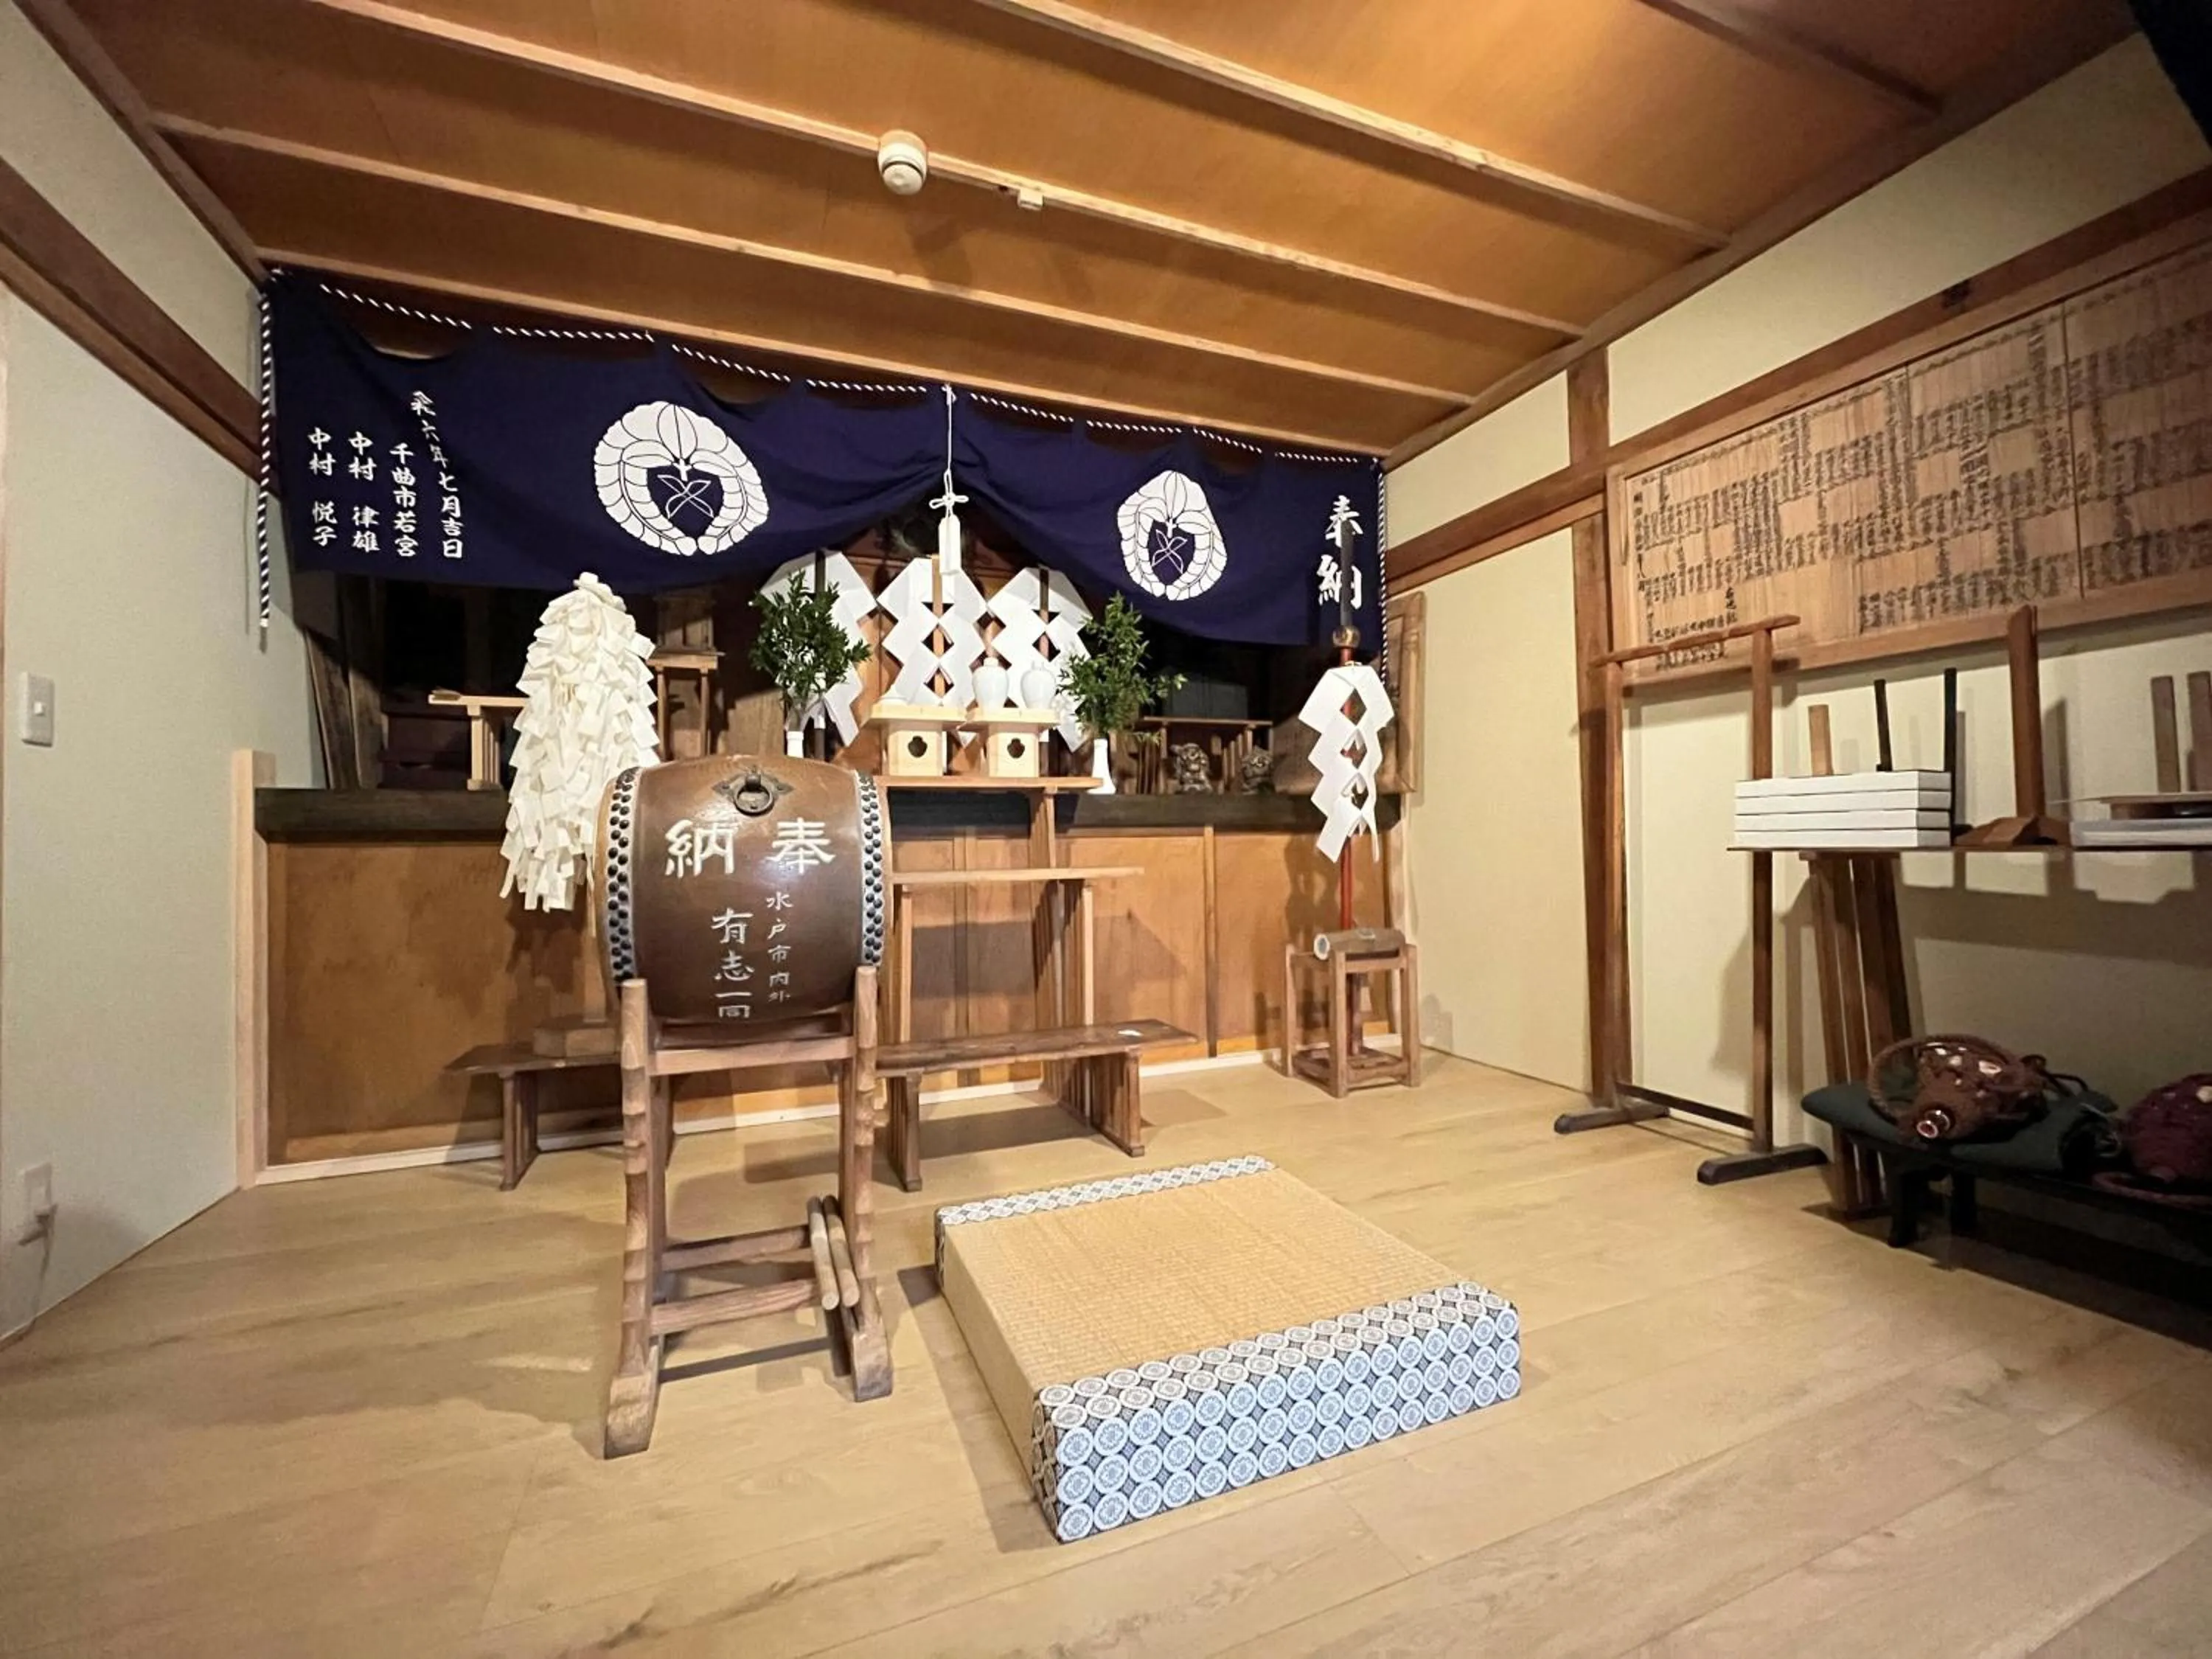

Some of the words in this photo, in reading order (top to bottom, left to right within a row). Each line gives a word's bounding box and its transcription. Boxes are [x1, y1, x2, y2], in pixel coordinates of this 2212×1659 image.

[307, 427, 336, 476] 中村
[348, 431, 378, 481] 中村
[312, 501, 338, 546] 悦子
[389, 442, 419, 557] 千曲市若宮
[1316, 495, 1363, 610] 奉納
[712, 907, 754, 1018] 有志一同
